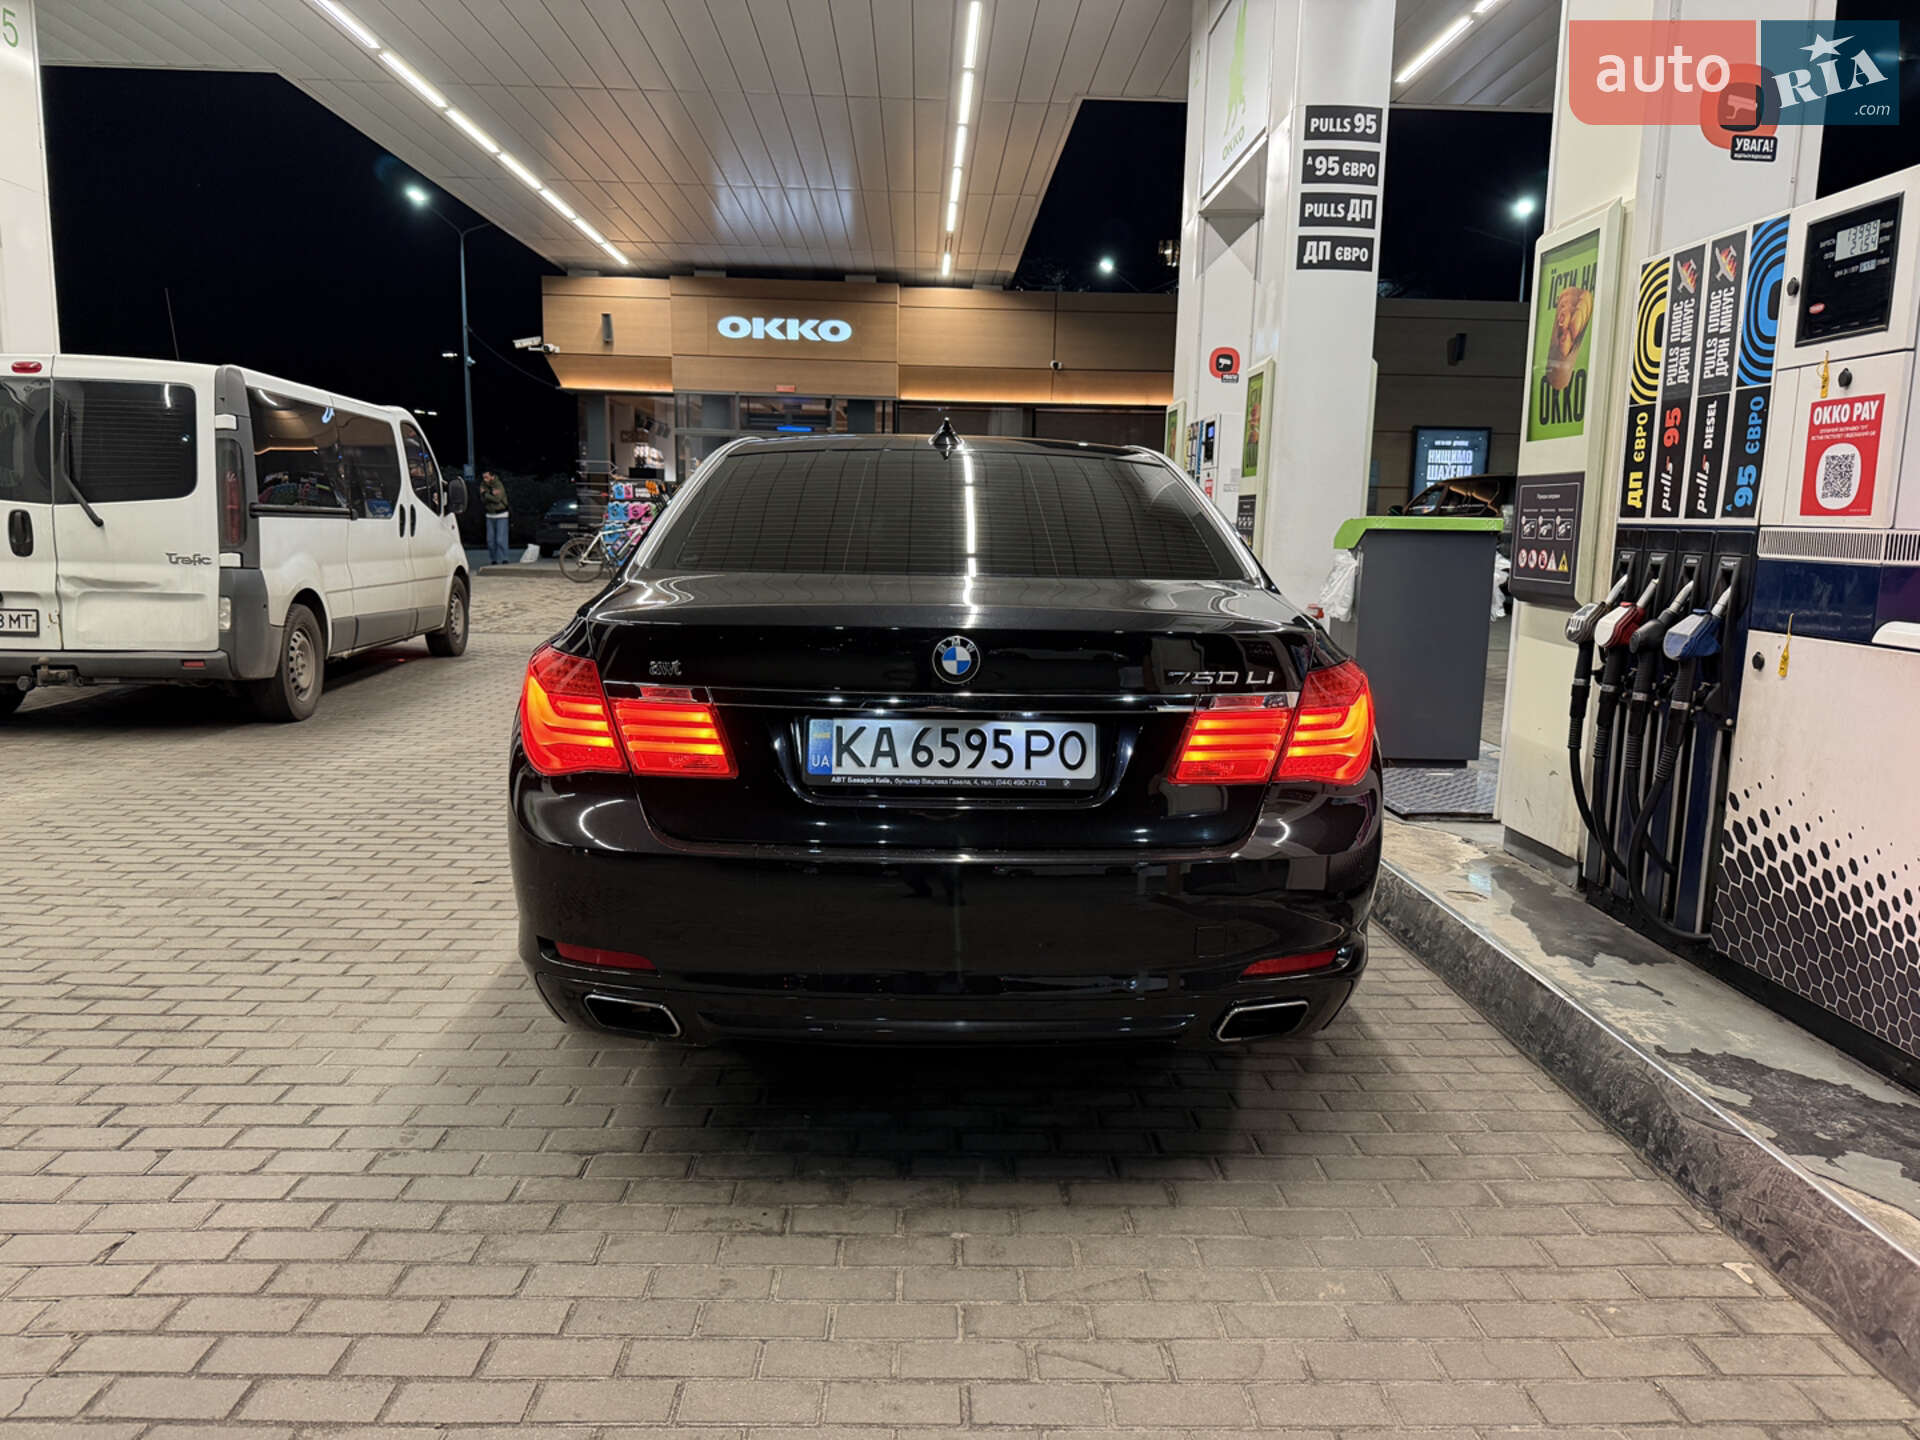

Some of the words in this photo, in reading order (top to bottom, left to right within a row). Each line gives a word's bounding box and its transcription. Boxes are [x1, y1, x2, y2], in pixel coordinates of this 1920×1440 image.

[3, 8, 18, 47] 5
[1310, 117, 1351, 133] PULLS
[1353, 112, 1377, 134] 95
[1735, 137, 1774, 152] УВАГА!
[1342, 162, 1376, 178] ЄВРО
[1304, 202, 1345, 218] PULLS
[1346, 198, 1373, 222] ДП
[1303, 240, 1331, 264] ДП
[1335, 246, 1369, 262] ЄВРО
[717, 316, 852, 342] OKKO
[1670, 299, 1684, 343] ПЛЮС
[1681, 297, 1696, 344] МІНУС
[1708, 289, 1723, 333] ПЛЮС
[1720, 286, 1736, 334] МІНУС
[1666, 345, 1680, 387] PULLS
[1677, 346, 1692, 384] ДРОН
[1703, 336, 1718, 379] PULLS
[1716, 337, 1731, 377] ДРОН
[1663, 407, 1682, 448] 95
[1704, 400, 1718, 449] DIESEL
[1745, 395, 1765, 455] ЄВРО
[1813, 403, 1851, 426] OKKO
[1853, 400, 1880, 422] PAY
[1633, 412, 1649, 462] ЄВРО
[1627, 471, 1644, 509] ДП
[166, 552, 212, 567] Trafic
[9, 614, 32, 630] MT
[1167, 671, 1239, 685] 750
[812, 754, 830, 768] UA
[835, 725, 900, 769] KA
[911, 726, 1014, 770] 6595
[1024, 729, 1088, 771] PO
